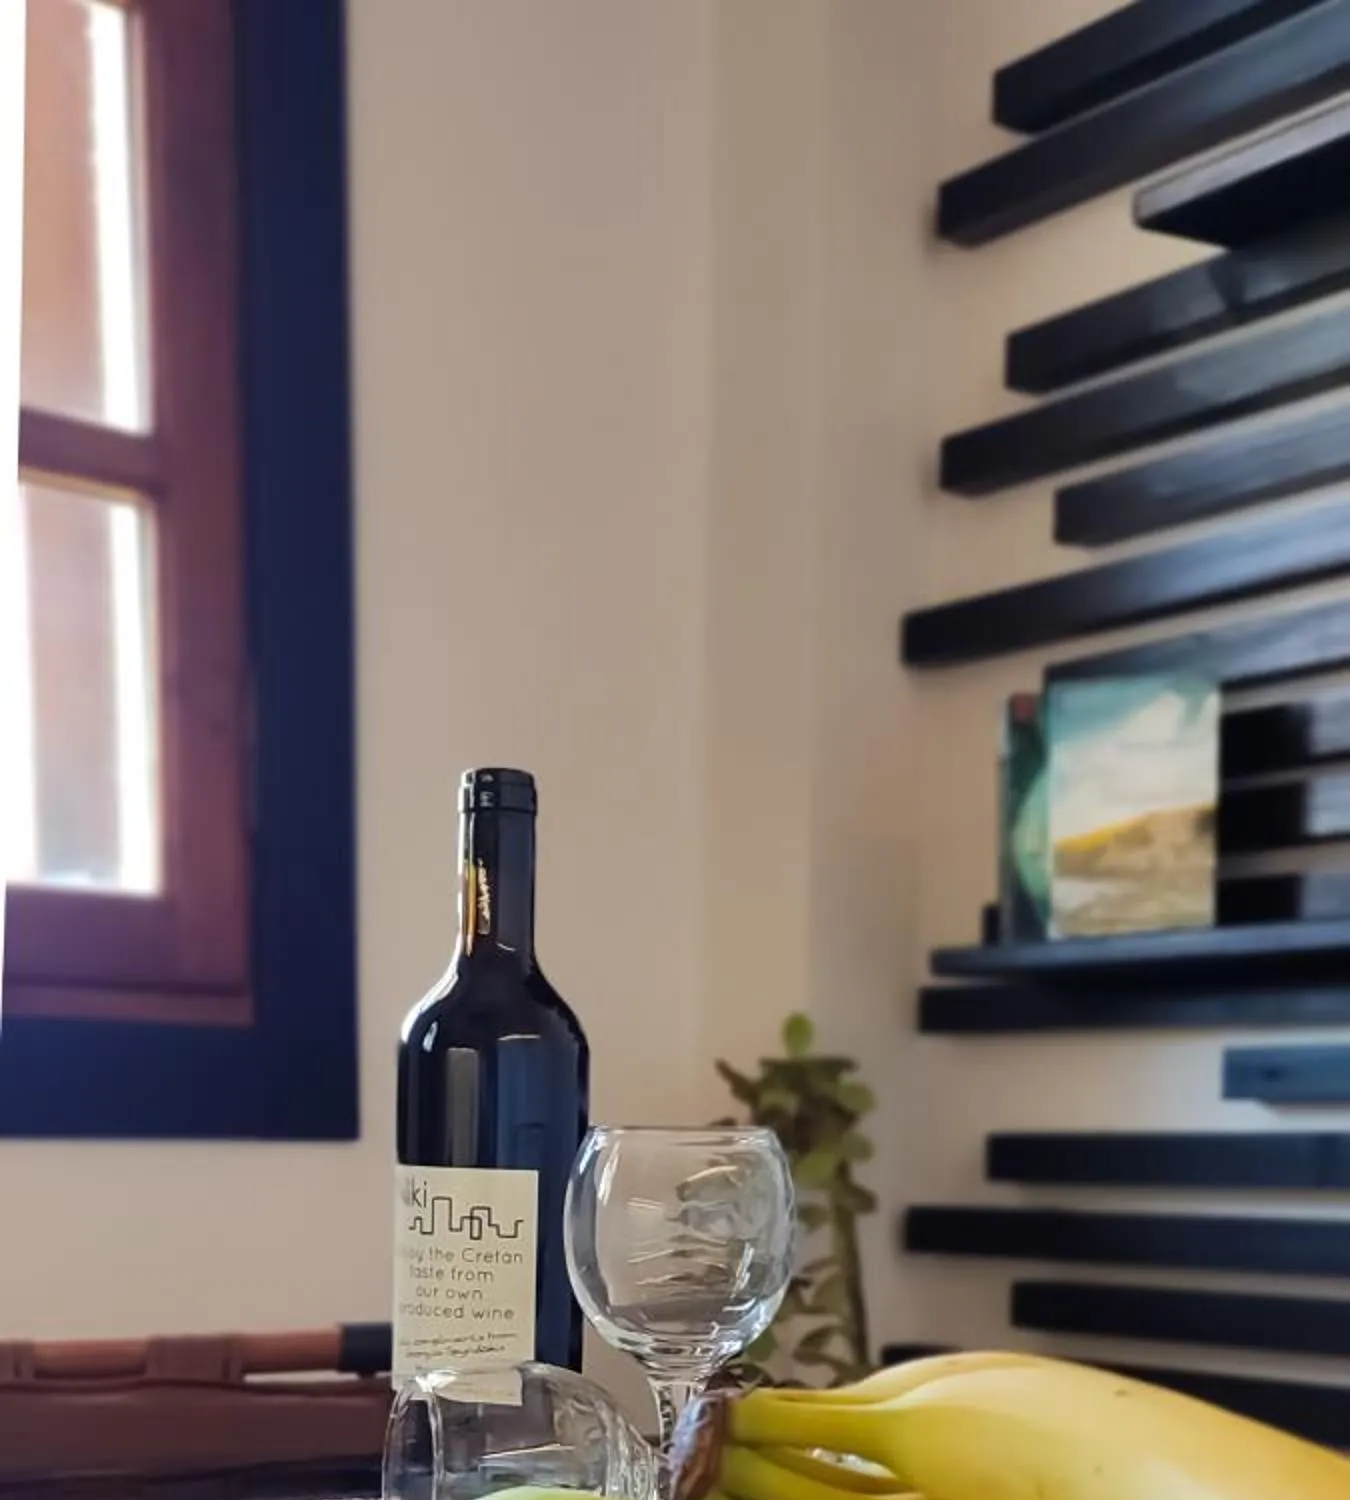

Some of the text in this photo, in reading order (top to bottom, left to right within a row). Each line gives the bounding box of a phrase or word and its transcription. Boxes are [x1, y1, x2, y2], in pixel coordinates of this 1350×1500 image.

[429, 1247, 454, 1261] the
[462, 1248, 523, 1264] Cretan
[451, 1268, 493, 1282] from
[416, 1286, 483, 1300] our own
[472, 1306, 515, 1320] wine
